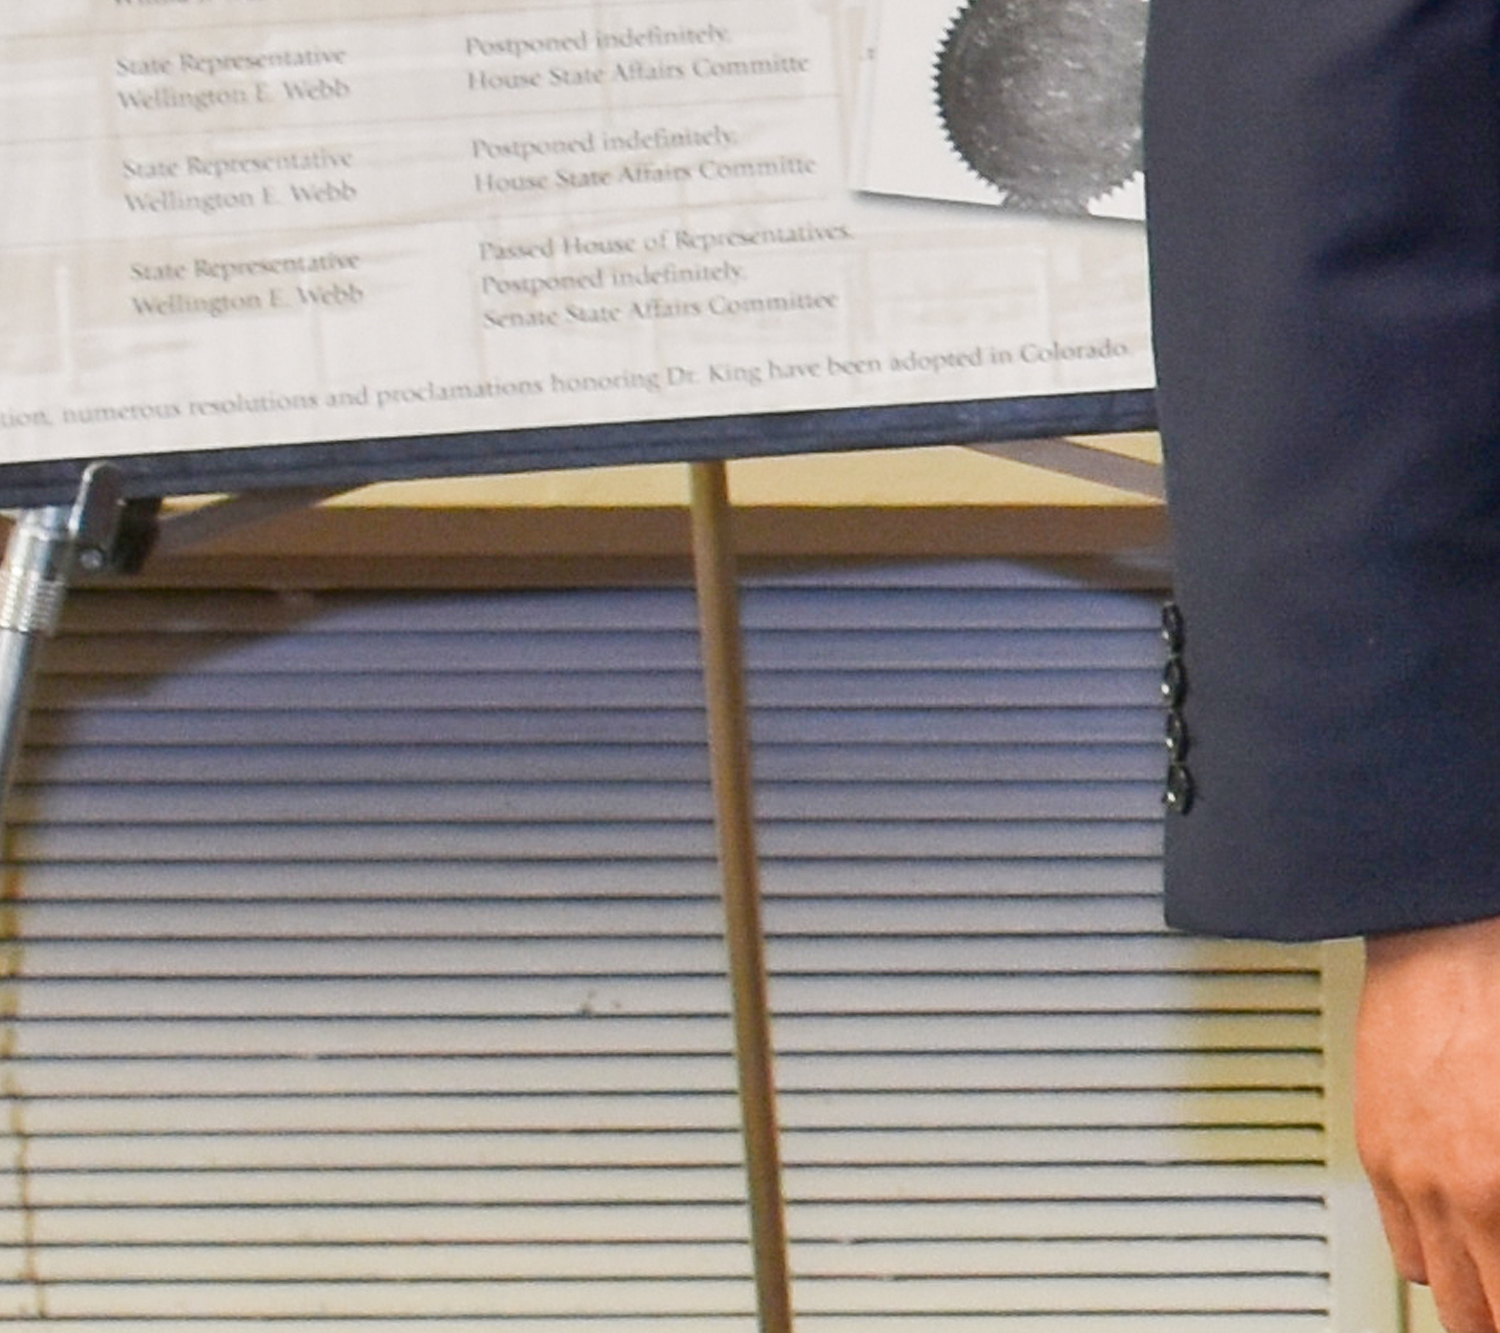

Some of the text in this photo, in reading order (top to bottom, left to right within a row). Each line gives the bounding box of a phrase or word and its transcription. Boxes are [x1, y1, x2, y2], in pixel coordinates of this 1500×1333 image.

[464, 32, 588, 57] Postponed
[116, 49, 346, 76] State Representative
[467, 71, 541, 90] House
[548, 68, 608, 86] State
[612, 61, 686, 81] Affairs
[117, 87, 249, 110] Wellington
[282, 79, 351, 100] Webb
[471, 133, 596, 160] Postponed
[122, 148, 353, 179] State Representative
[474, 174, 549, 192] House
[554, 170, 616, 189] State
[615, 164, 695, 183] Affairs
[123, 189, 255, 213] Wellington
[289, 181, 358, 203] Webb
[479, 237, 556, 261] Passed
[562, 237, 636, 254] House
[643, 230, 668, 253] of
[130, 252, 360, 281] State Representative
[482, 268, 605, 296] Postponed
[131, 293, 263, 316] Wellington
[296, 284, 364, 304] Webb
[483, 295, 837, 328] Senate State Affairs Committee
[62, 404, 182, 423] numerous
[188, 394, 320, 415] resolutions
[325, 386, 370, 407] and
[376, 381, 544, 407] proclamations
[549, 372, 663, 392] honoring
[708, 364, 762, 386] King
[766, 360, 821, 379] have
[826, 356, 882, 376] been
[888, 348, 985, 372] adopted
[987, 347, 1016, 365] in
